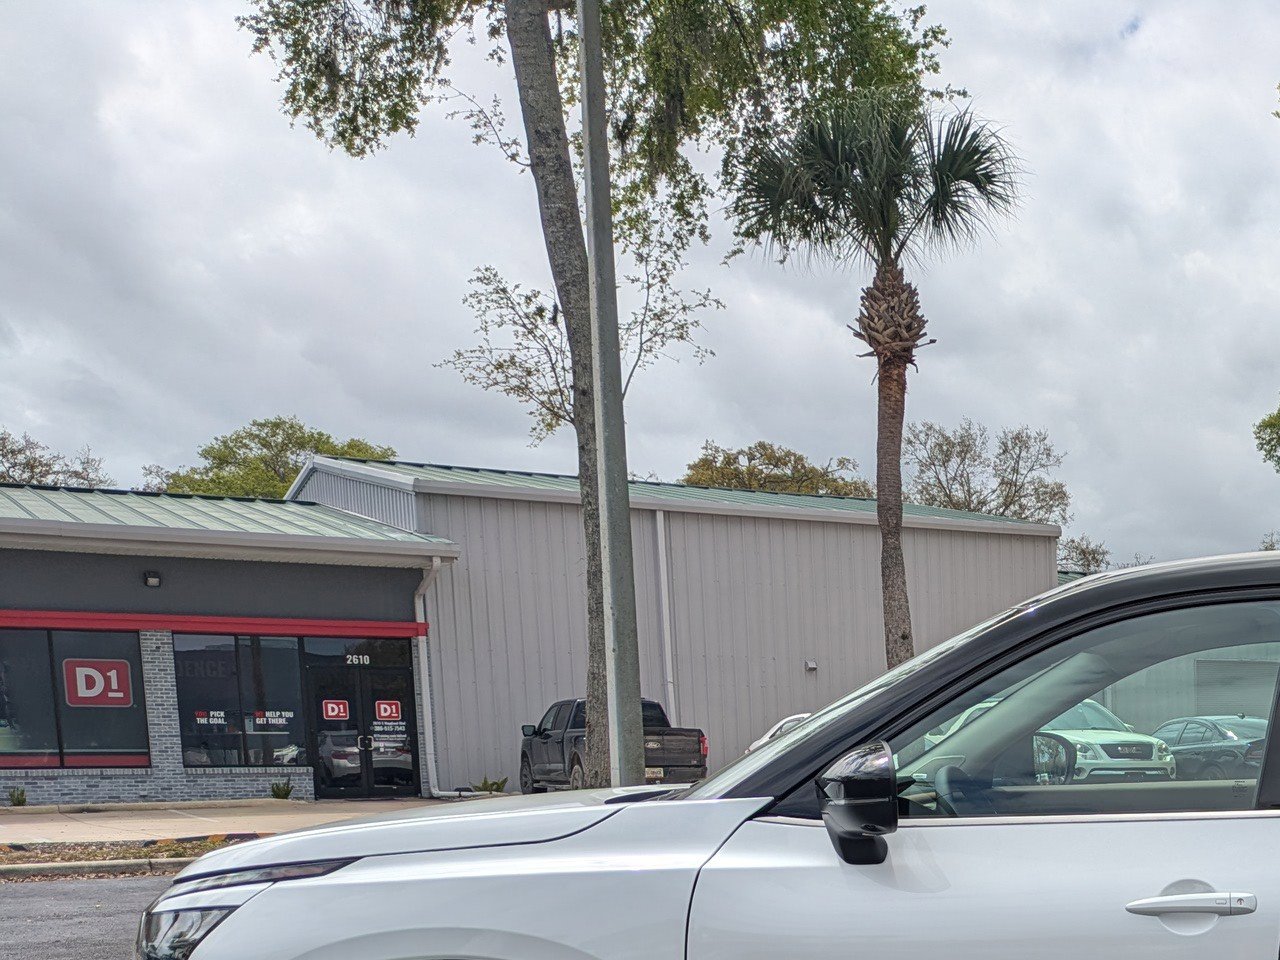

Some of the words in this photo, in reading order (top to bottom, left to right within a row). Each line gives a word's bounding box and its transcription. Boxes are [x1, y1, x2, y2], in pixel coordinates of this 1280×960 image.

[346, 655, 370, 664] 2610
[75, 667, 124, 698] D1
[327, 703, 346, 716] D1
[380, 704, 398, 717] D1
